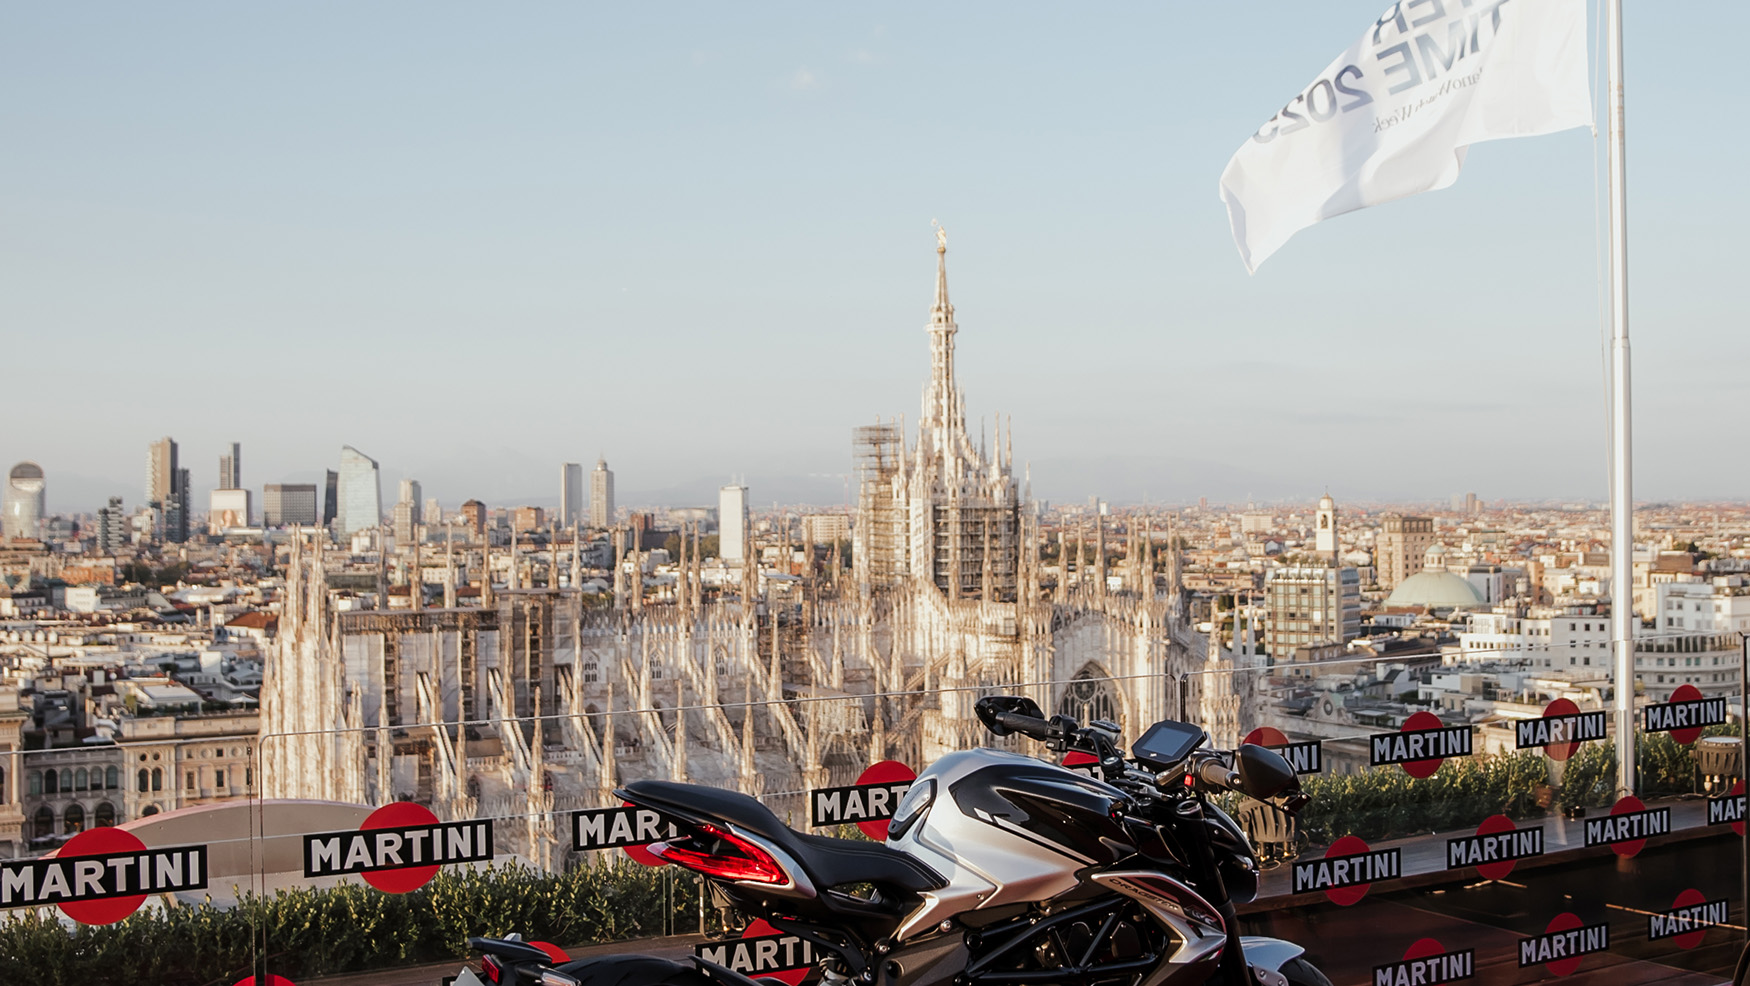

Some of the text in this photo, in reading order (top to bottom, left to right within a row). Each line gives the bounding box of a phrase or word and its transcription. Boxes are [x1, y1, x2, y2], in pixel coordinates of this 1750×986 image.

[1518, 713, 1604, 746] MARTINI
[1647, 700, 1725, 730] MARTINI
[1374, 730, 1469, 763] MARTINI
[1587, 810, 1669, 845] MARTINI
[311, 823, 487, 872] MARTINI
[1450, 829, 1541, 867] MARTINI
[2, 850, 200, 904] MARTINI
[1296, 852, 1398, 892] MARTINI
[1109, 878, 1179, 911] DRAGSTER
[1650, 901, 1727, 938] MARTINI
[702, 936, 820, 976] MARTI
[1520, 926, 1607, 965] MARTINI
[1375, 952, 1473, 986] MARTINI
